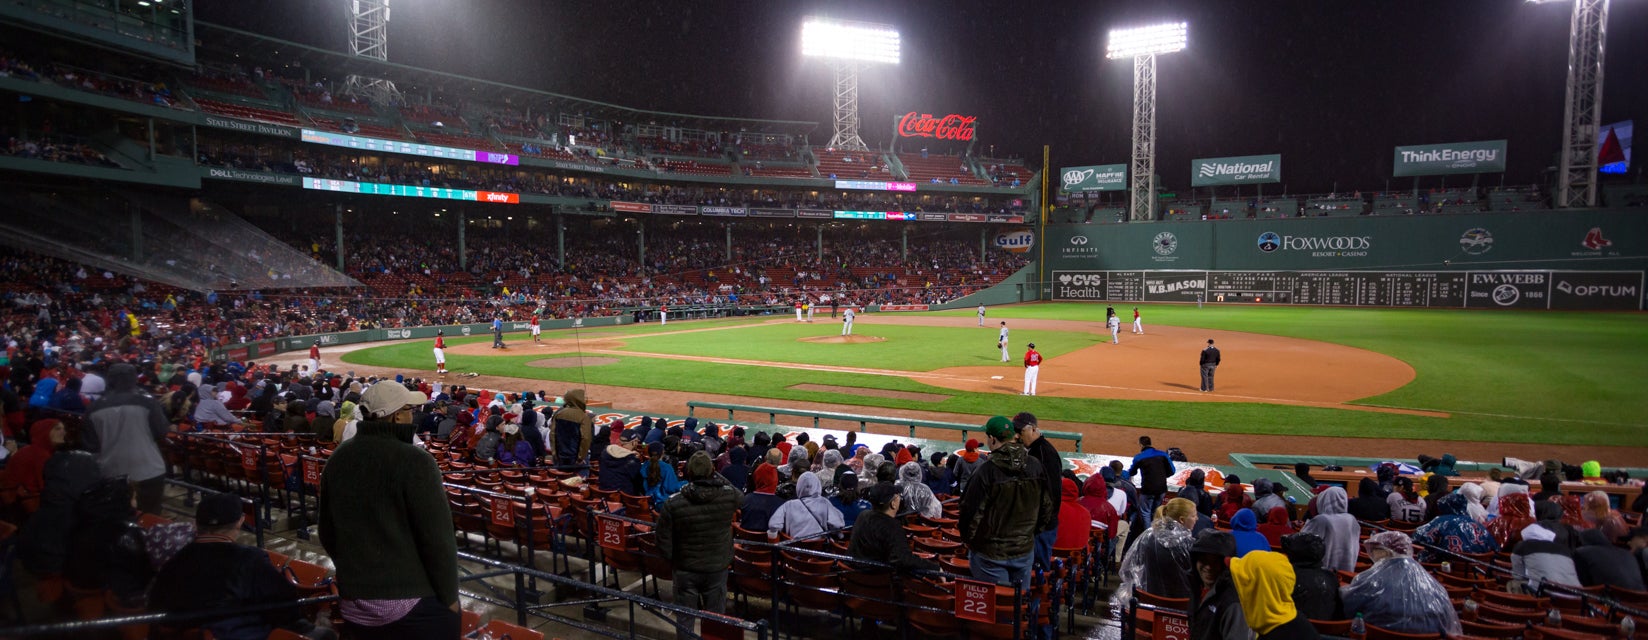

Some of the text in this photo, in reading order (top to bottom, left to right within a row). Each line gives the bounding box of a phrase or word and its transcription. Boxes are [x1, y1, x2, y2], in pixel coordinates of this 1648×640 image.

[206, 117, 292, 137] STATE STREET PAVILION
[898, 111, 976, 141] Coca-Cola
[1401, 148, 1496, 163] ThinkEnergy
[1215, 160, 1273, 175] National
[210, 169, 232, 178] DELL
[232, 171, 274, 183] Technologies
[1066, 171, 1082, 182] AAA
[487, 193, 509, 203] xfinity
[996, 235, 1031, 245] Gulf
[1283, 235, 1369, 250] FOXWOODS
[1072, 274, 1101, 286] CVS
[1500, 274, 1544, 284] WEBB
[1060, 286, 1101, 298] Health
[1148, 279, 1205, 294] W.B.MASON
[1575, 286, 1635, 296] OPTUM
[307, 470, 317, 480] 25
[496, 510, 509, 521] 24
[1402, 508, 1420, 521] 15
[603, 519, 620, 527] FIELD
[604, 532, 620, 544] 23
[963, 583, 988, 593] FIELD
[966, 591, 984, 599] BOX
[963, 599, 987, 615] 22
[1165, 624, 1188, 634] BOX
